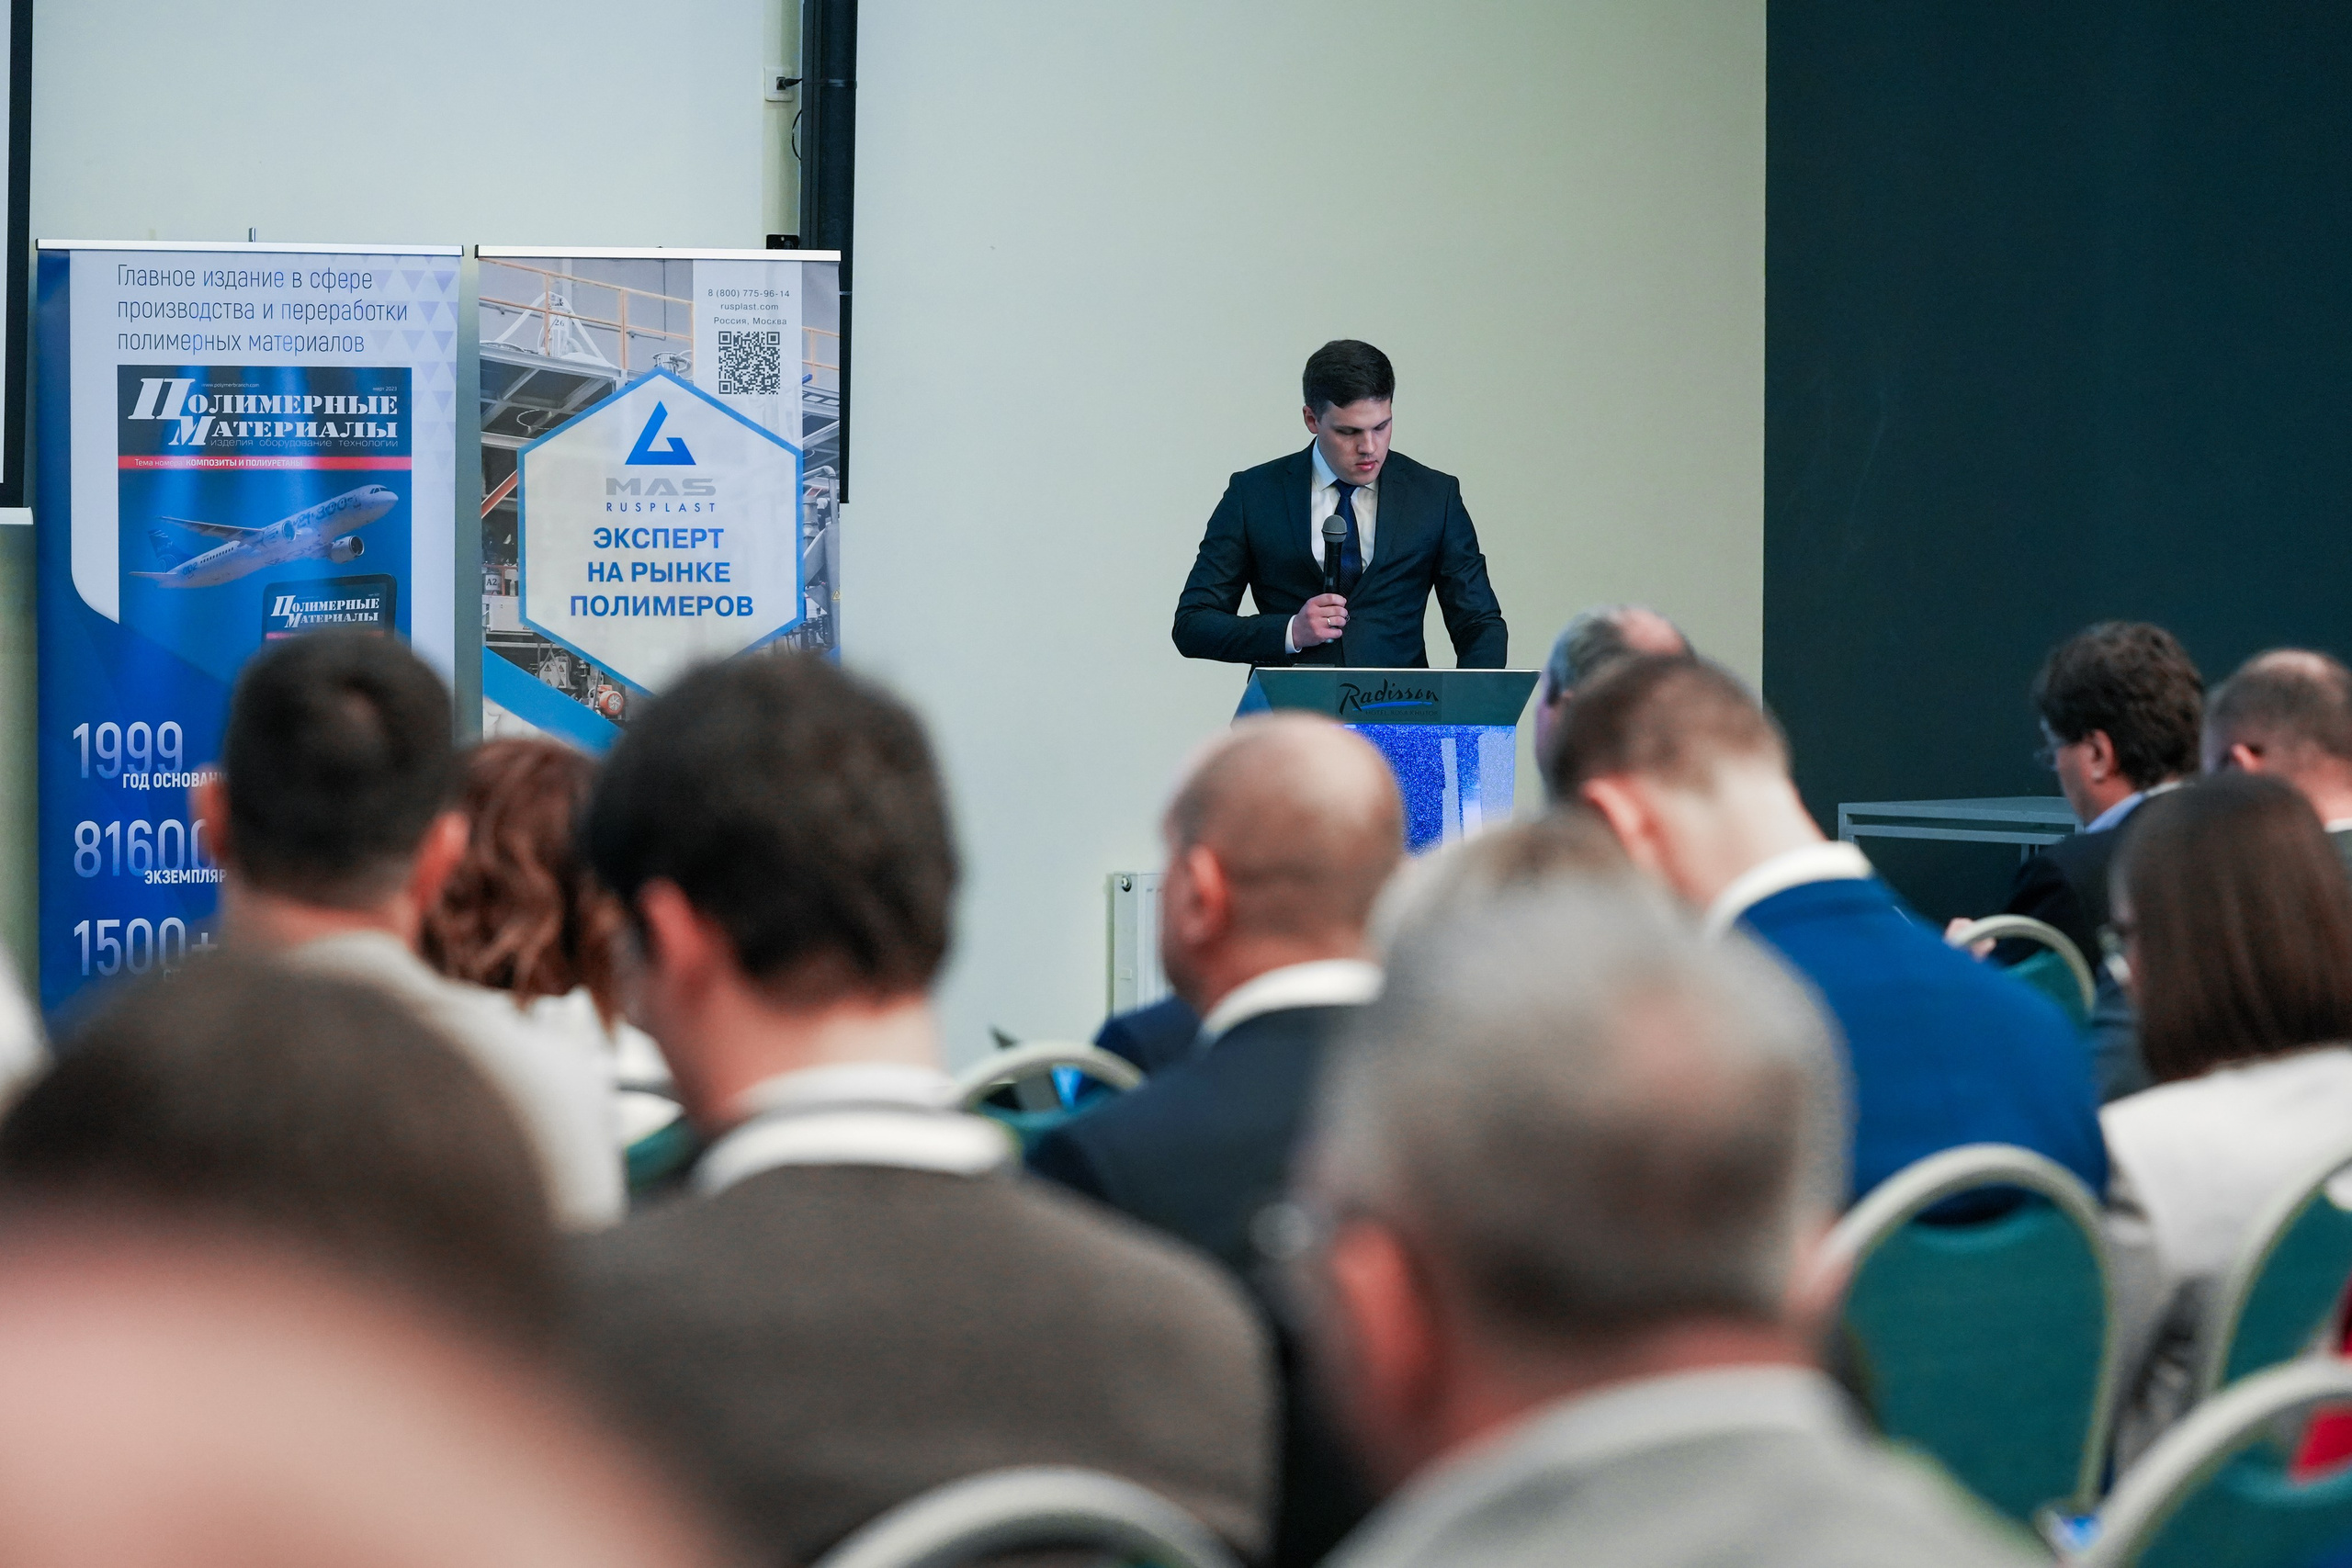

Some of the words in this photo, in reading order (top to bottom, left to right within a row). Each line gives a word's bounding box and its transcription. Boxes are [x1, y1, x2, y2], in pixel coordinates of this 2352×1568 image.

[118, 264, 196, 287] Главное
[203, 269, 284, 290] издание
[292, 271, 302, 288] в
[310, 266, 372, 293] сфере
[707, 288, 714, 297] 8
[716, 288, 741, 299] (800)
[743, 289, 790, 298] 775-96-14
[118, 301, 254, 323] производства
[263, 302, 274, 320] и
[281, 299, 408, 325] переработки
[720, 302, 779, 311] rusplast.com
[713, 316, 750, 325] Россия,
[752, 317, 787, 325] Москва
[118, 333, 242, 355] полимерных
[249, 334, 365, 356] материалов
[210, 439, 254, 447] изделия
[259, 437, 333, 448] оборудование
[338, 439, 399, 447] технологии
[605, 478, 717, 496] MAS
[605, 502, 716, 513] RUSPLAST
[593, 527, 725, 549] ЭКСПЕРТ
[587, 561, 625, 583] НА
[631, 562, 731, 583] РЫНКЕ
[570, 594, 754, 617] ПОЛИМЕРОВ
[1339, 678, 1440, 716] Radisson
[73, 721, 183, 779] 1999
[122, 773, 151, 790] ГОД
